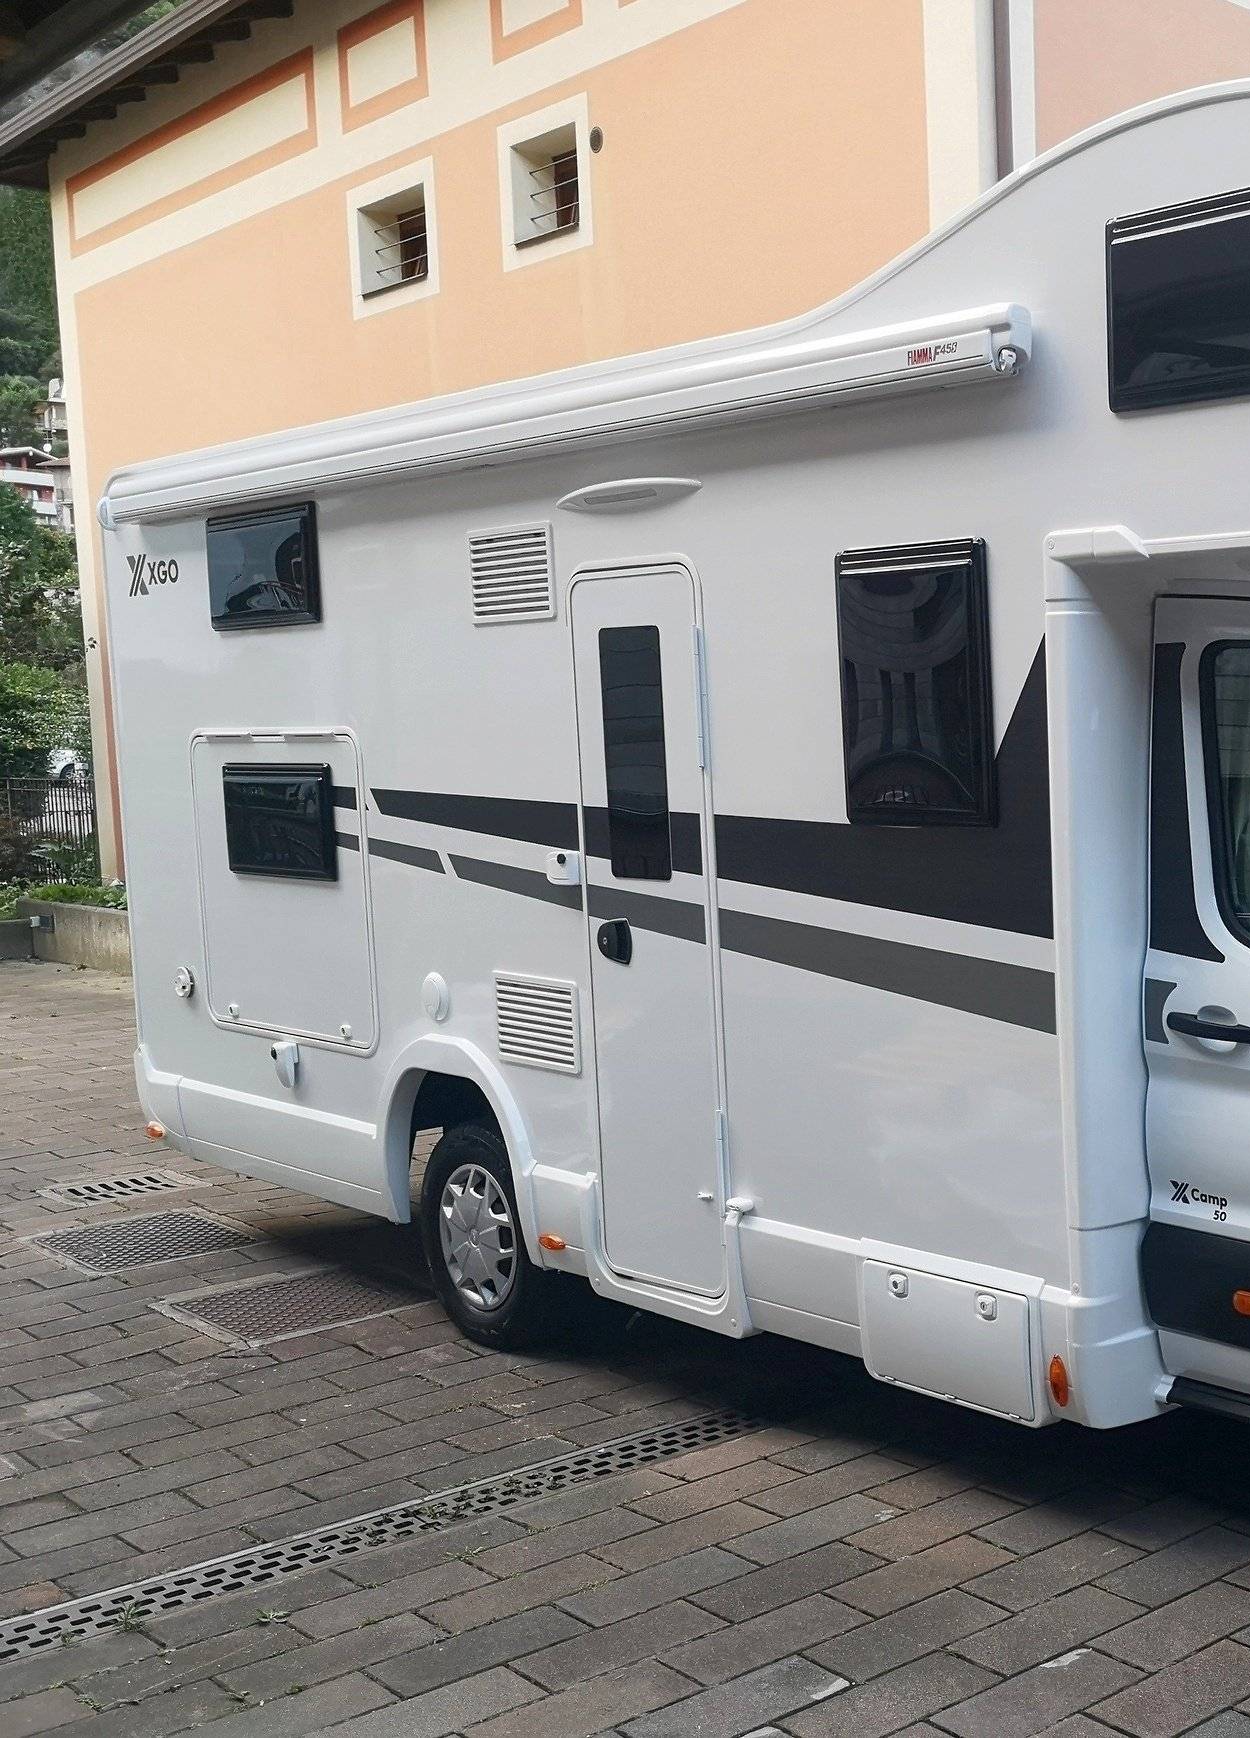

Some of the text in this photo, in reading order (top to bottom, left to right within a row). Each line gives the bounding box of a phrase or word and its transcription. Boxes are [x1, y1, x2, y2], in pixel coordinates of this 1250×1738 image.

[907, 347, 932, 366] FIAMMA
[147, 558, 178, 585] XGO
[1191, 1188, 1228, 1209] Camp
[1213, 1210, 1227, 1221] 50
